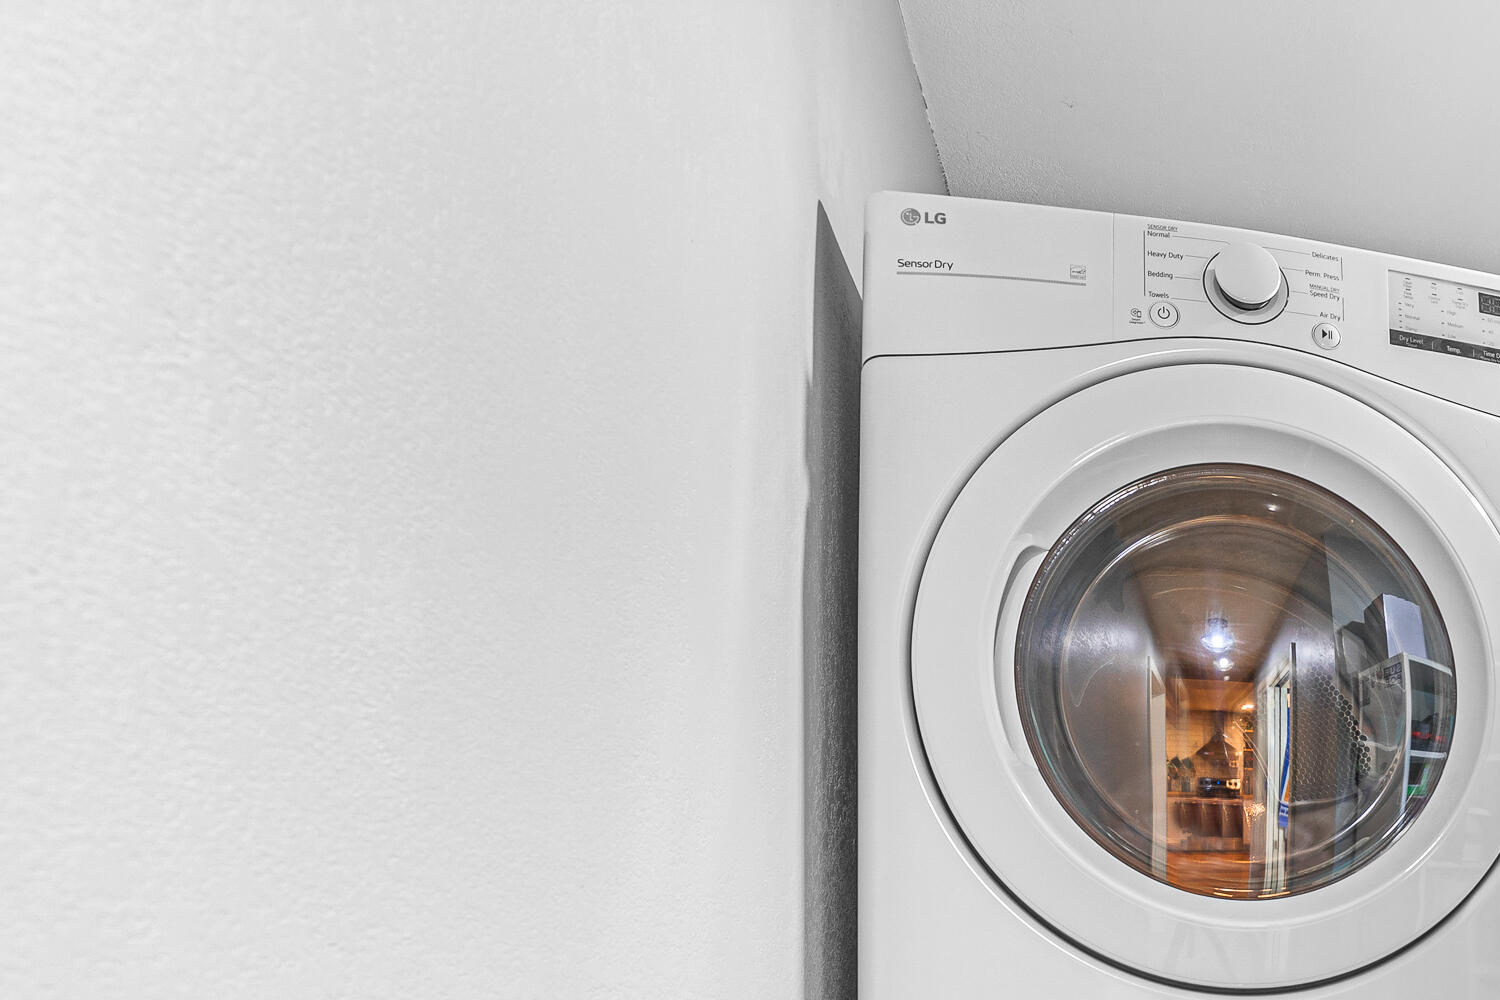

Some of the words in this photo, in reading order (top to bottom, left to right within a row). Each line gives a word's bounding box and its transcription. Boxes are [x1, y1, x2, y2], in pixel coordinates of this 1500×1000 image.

[924, 212, 947, 226] LG
[1147, 251, 1167, 259] Heavy
[1168, 252, 1184, 260] Duty
[1312, 251, 1339, 261] Delicates
[1147, 270, 1173, 280] Bedding
[1323, 272, 1340, 281] Press
[1148, 291, 1169, 299] Towels
[1309, 290, 1328, 299] Speed
[1329, 293, 1340, 302] Dry
[1330, 313, 1341, 322] Dry
[1482, 350, 1495, 358] Time
